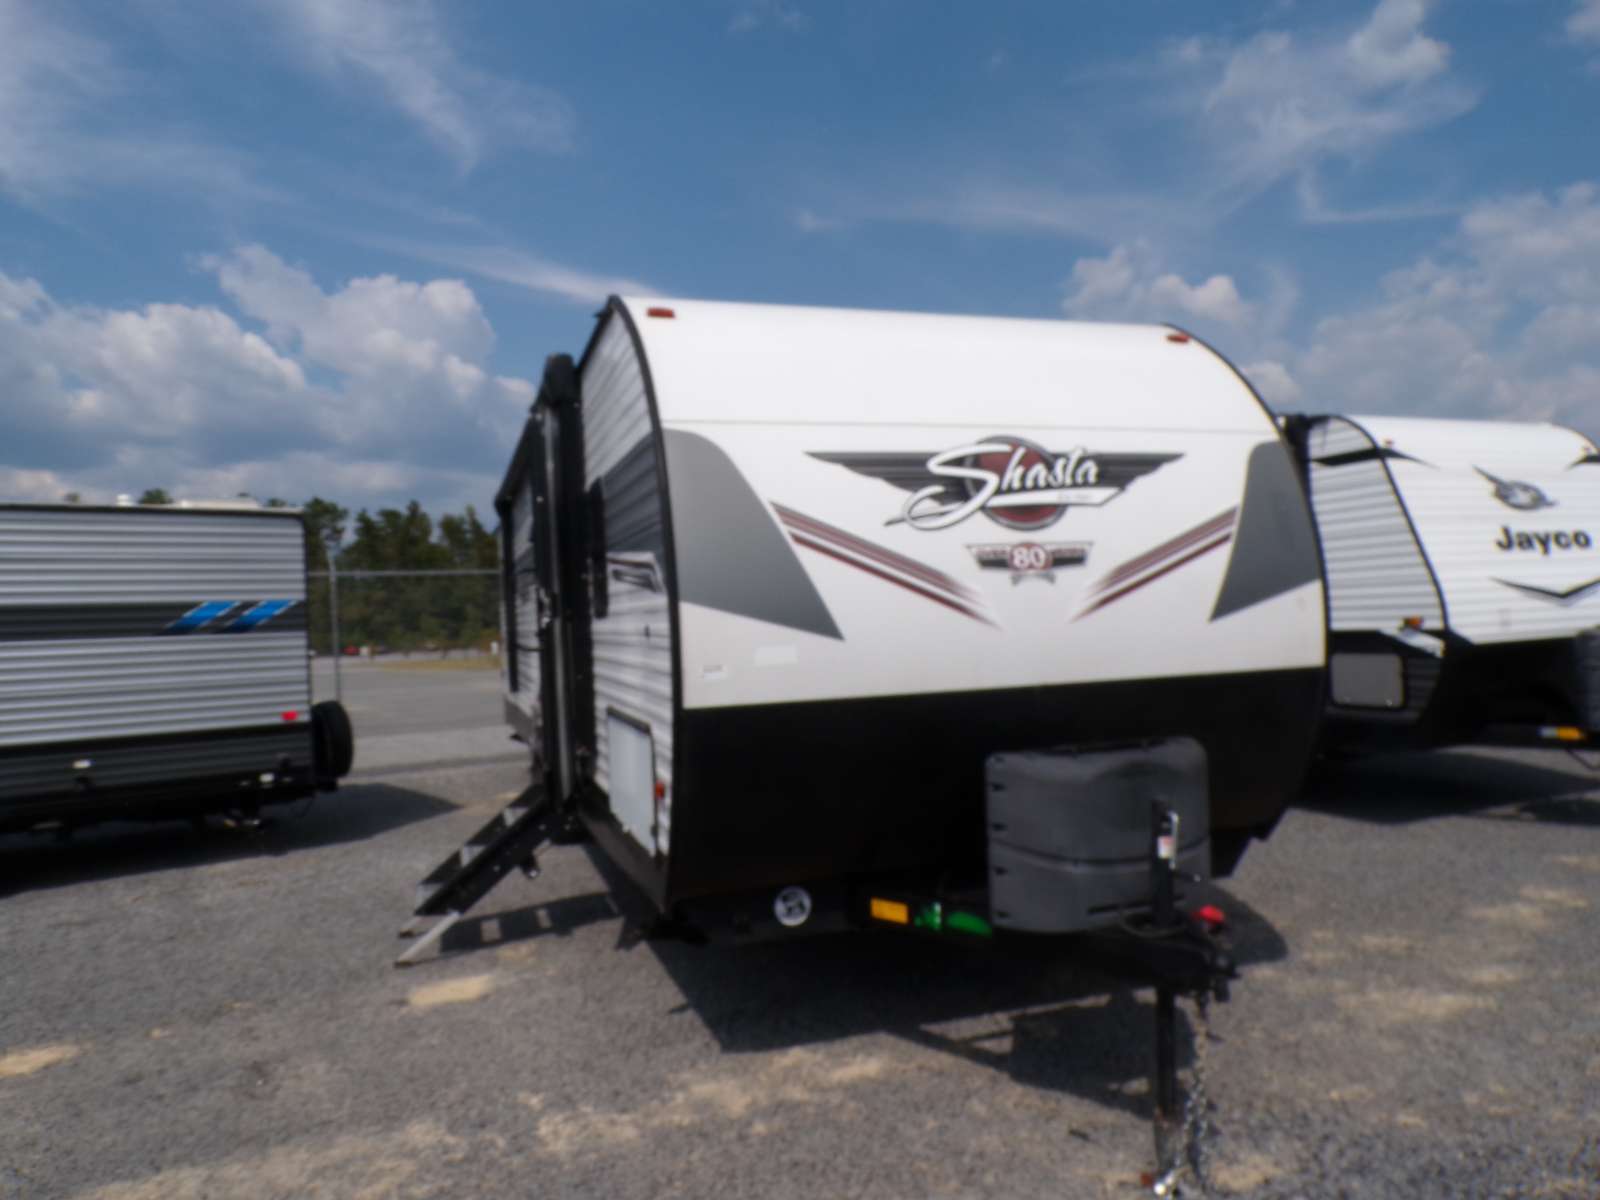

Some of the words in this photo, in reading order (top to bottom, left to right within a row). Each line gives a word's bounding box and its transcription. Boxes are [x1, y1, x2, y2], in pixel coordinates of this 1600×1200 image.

[884, 442, 1099, 531] Shasta
[1496, 525, 1592, 556] Jayco
[1012, 546, 1047, 569] 80
